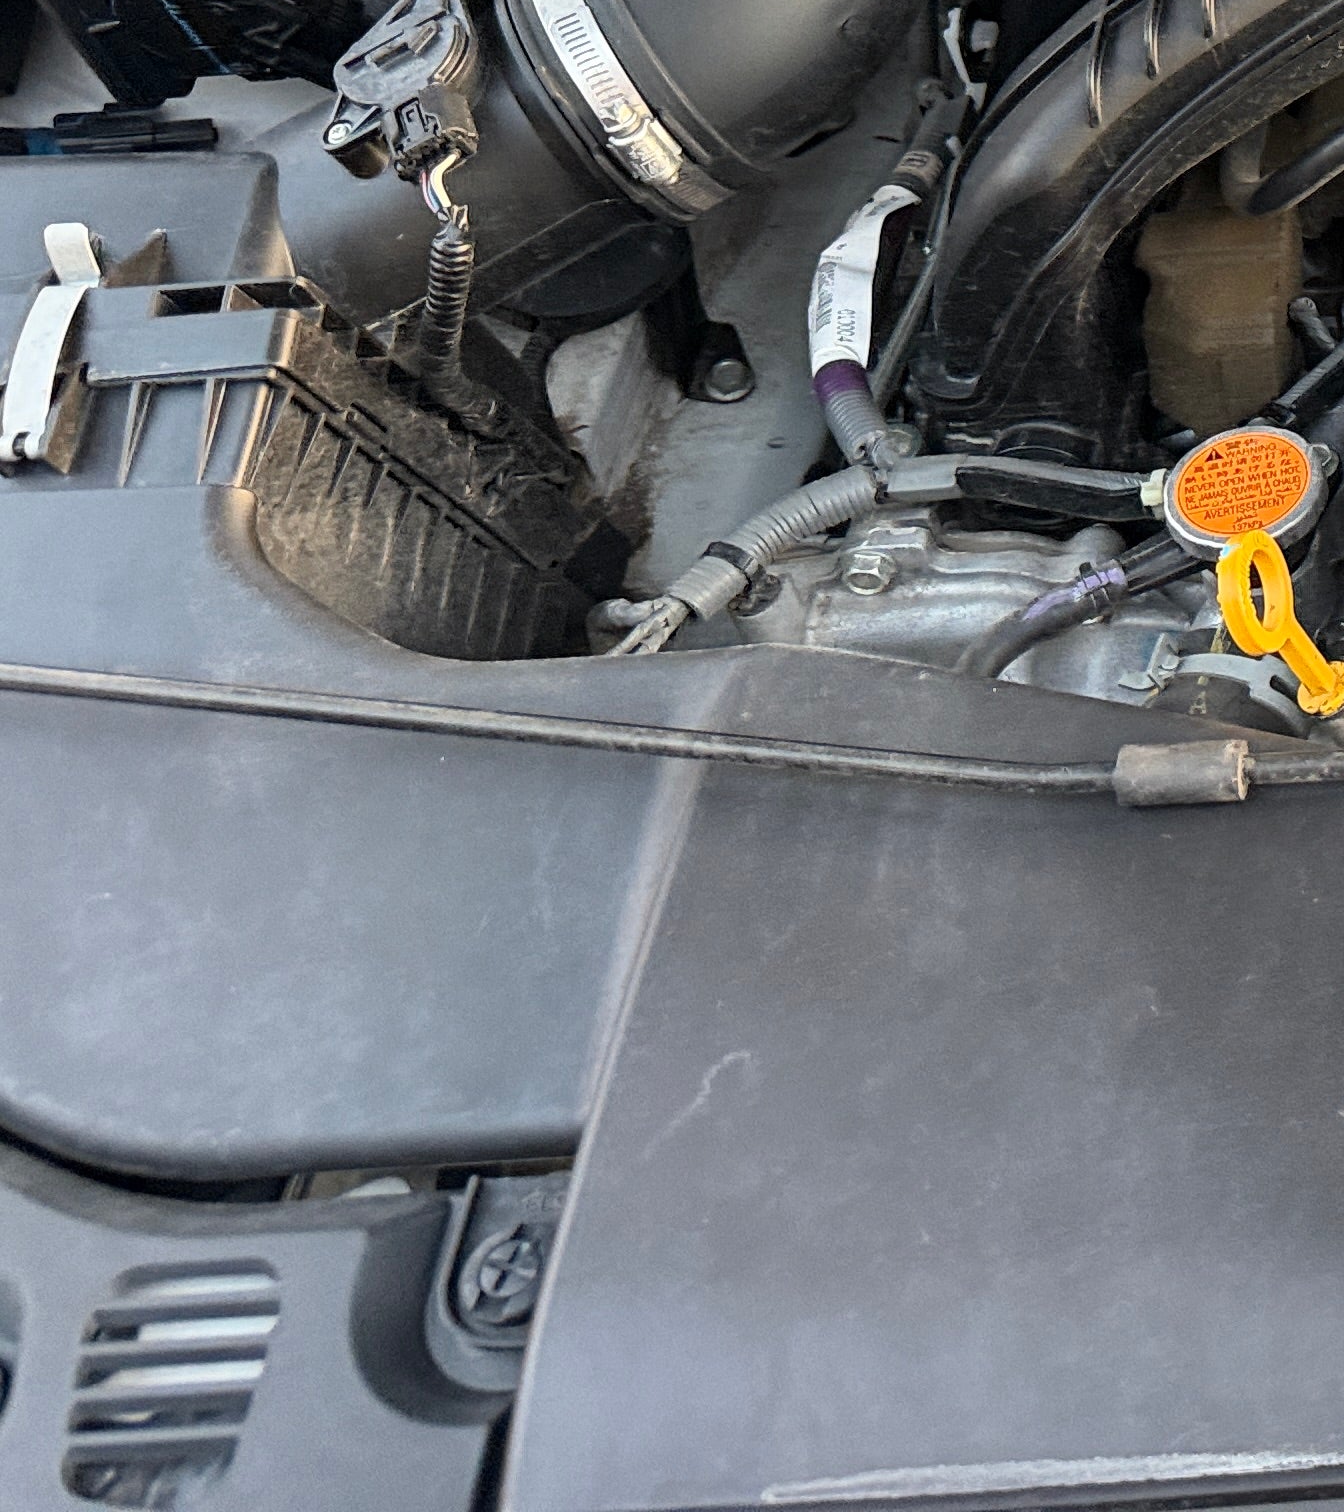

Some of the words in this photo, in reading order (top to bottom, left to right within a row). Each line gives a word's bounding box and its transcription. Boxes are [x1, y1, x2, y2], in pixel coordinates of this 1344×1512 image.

[1225, 442, 1276, 458] WARNING
[1184, 481, 1215, 494] NEVER
[1218, 476, 1244, 487] OPEN
[1247, 470, 1277, 482] WHEN
[1185, 495, 1195, 504] NE
[1198, 489, 1228, 501] JAMAIS
[1203, 496, 1286, 520] AVERTISSEMENT
